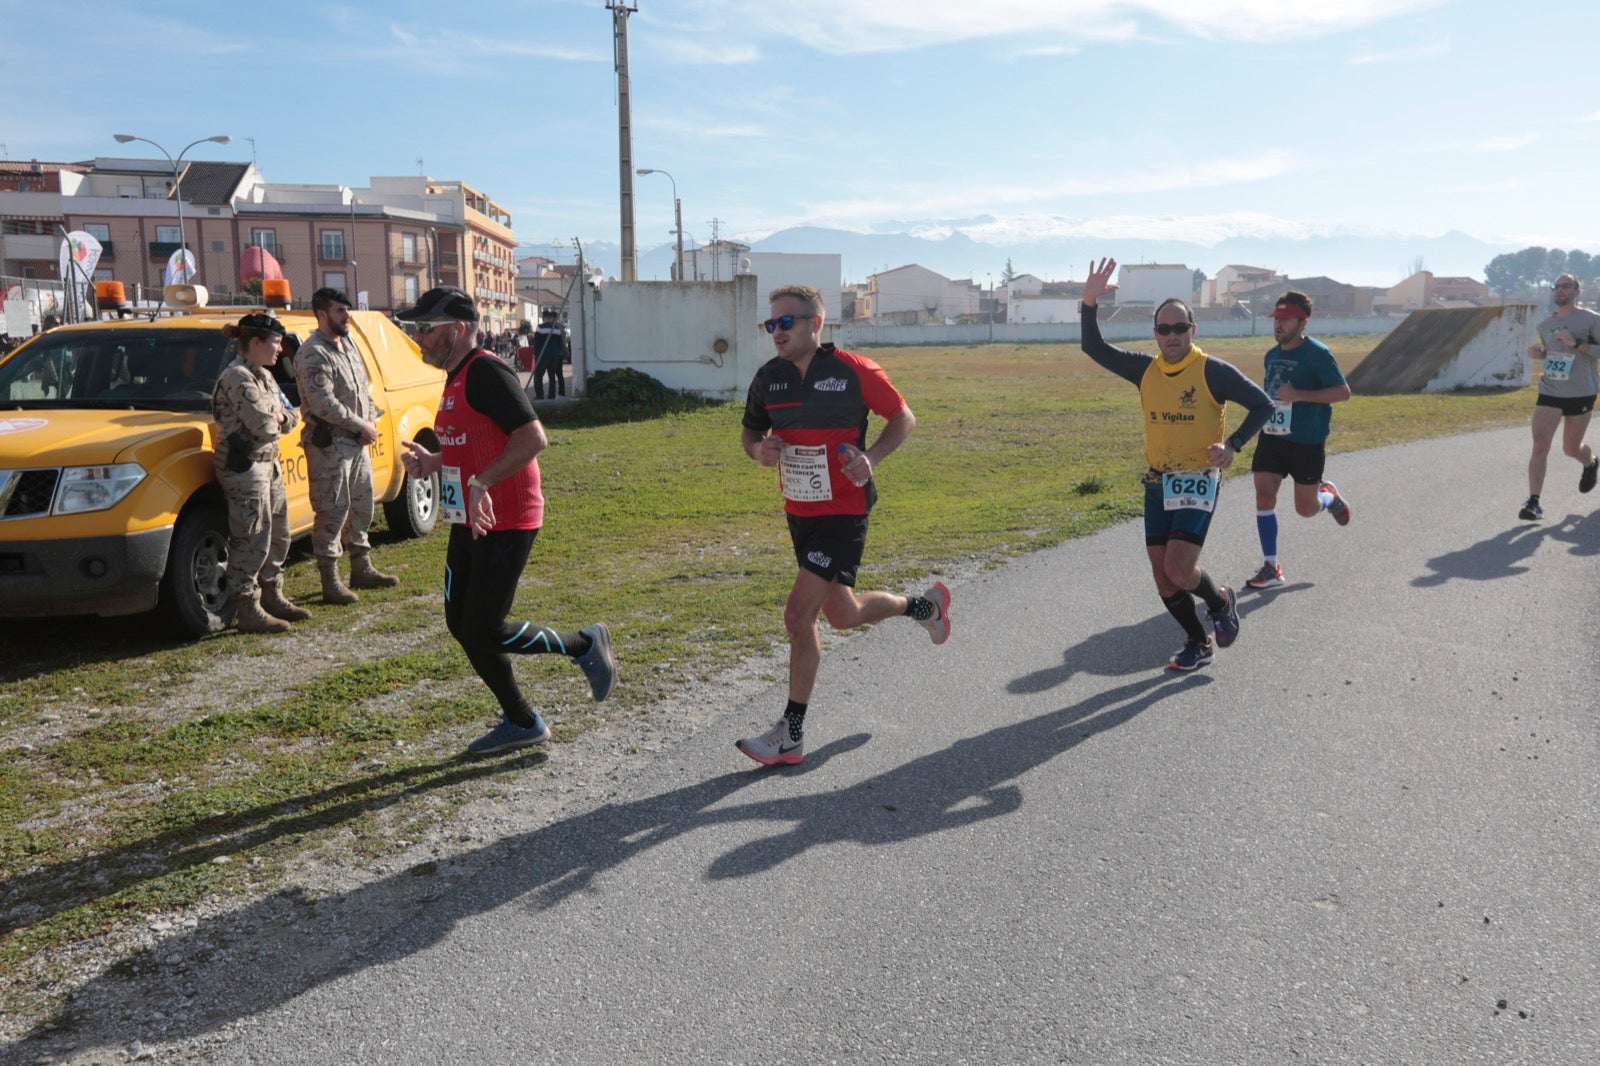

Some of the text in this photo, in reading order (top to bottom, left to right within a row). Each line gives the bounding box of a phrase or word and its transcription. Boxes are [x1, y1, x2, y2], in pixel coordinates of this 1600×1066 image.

[1546, 360, 1566, 371] 752
[1162, 411, 1195, 422] Vigilsa
[809, 474, 822, 490] 6
[1171, 478, 1208, 496] 626
